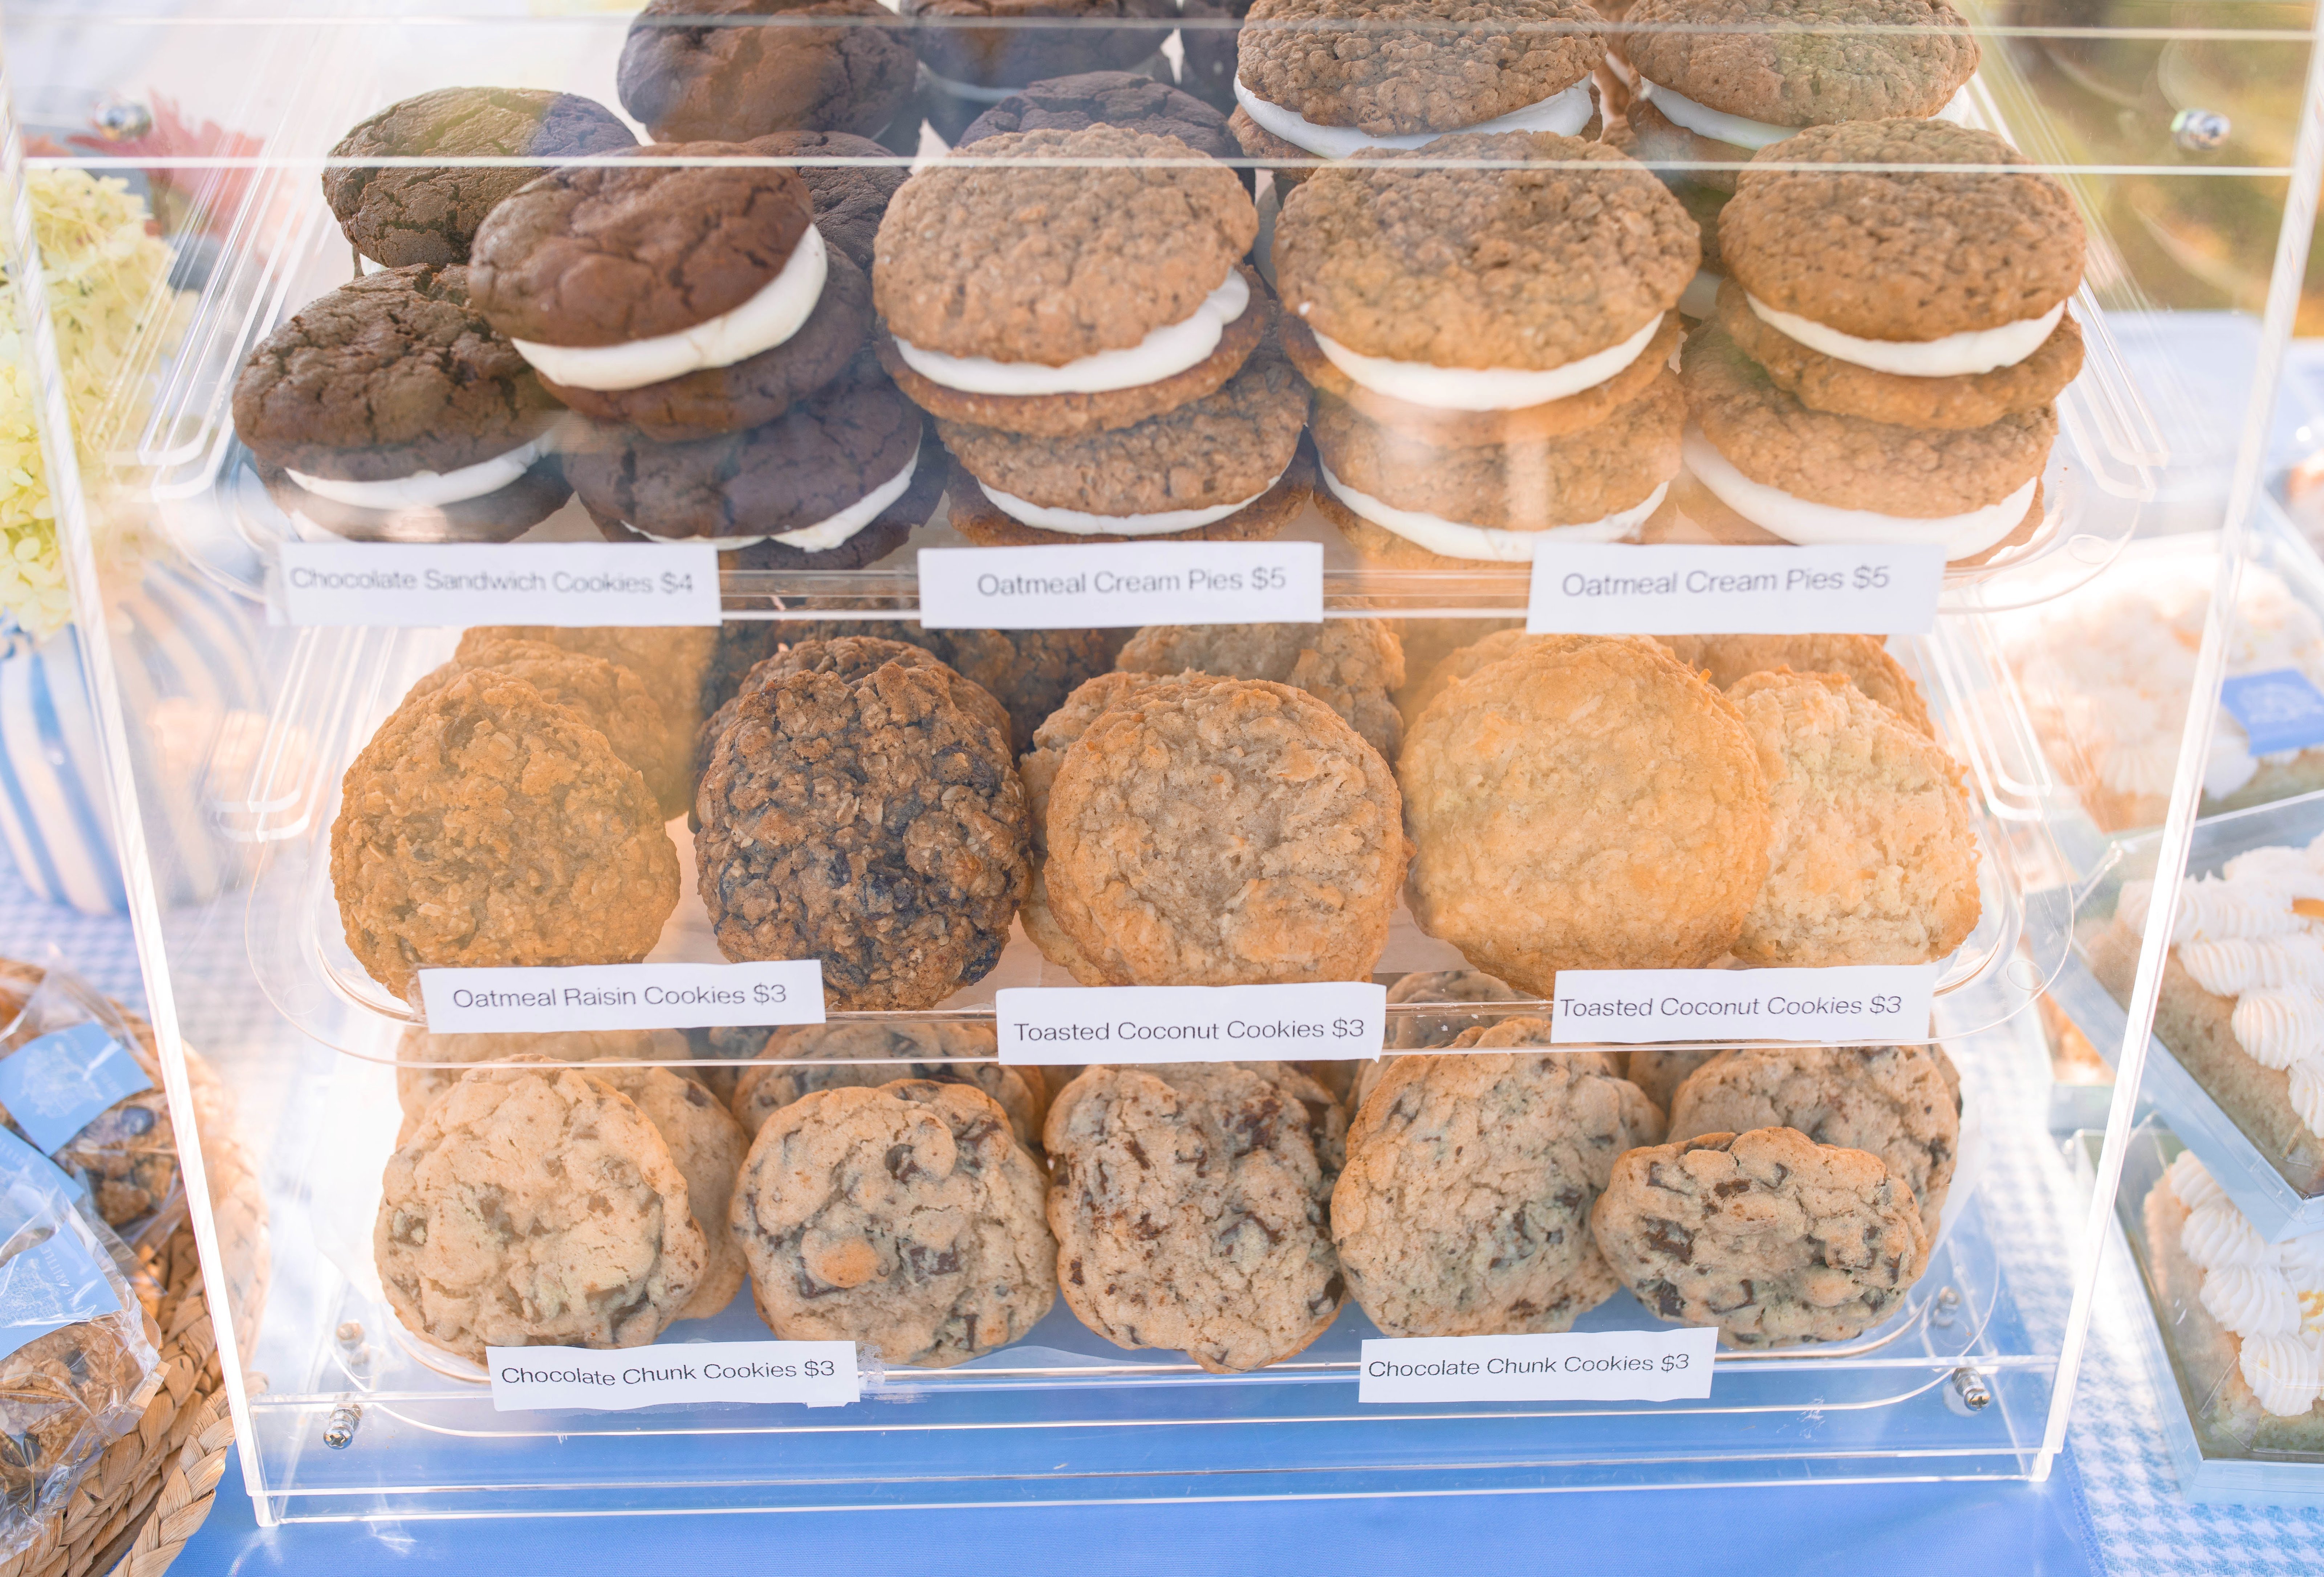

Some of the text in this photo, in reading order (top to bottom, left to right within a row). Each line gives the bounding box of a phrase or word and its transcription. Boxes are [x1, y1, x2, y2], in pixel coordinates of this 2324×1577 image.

[291, 567, 693, 595] Chocolate Sandwich Cookies $4
[977, 566, 1286, 596] Oatmeal Cream Pies $5
[1562, 565, 1889, 596] Oatmeal Cream Pies $5
[453, 983, 787, 1008] Oatmeal Raisin Cookies $3
[1560, 994, 1902, 1017] Toasted Coconut Cookies $3
[1014, 1017, 1364, 1041] Toasted Coconut Cookies $3
[40, 1247, 70, 1287] BRITTLE
[501, 1359, 835, 1386] Chocolate Chunk Cookies $3
[1368, 1353, 1689, 1377] Chocolate Chunk Cookies $3
